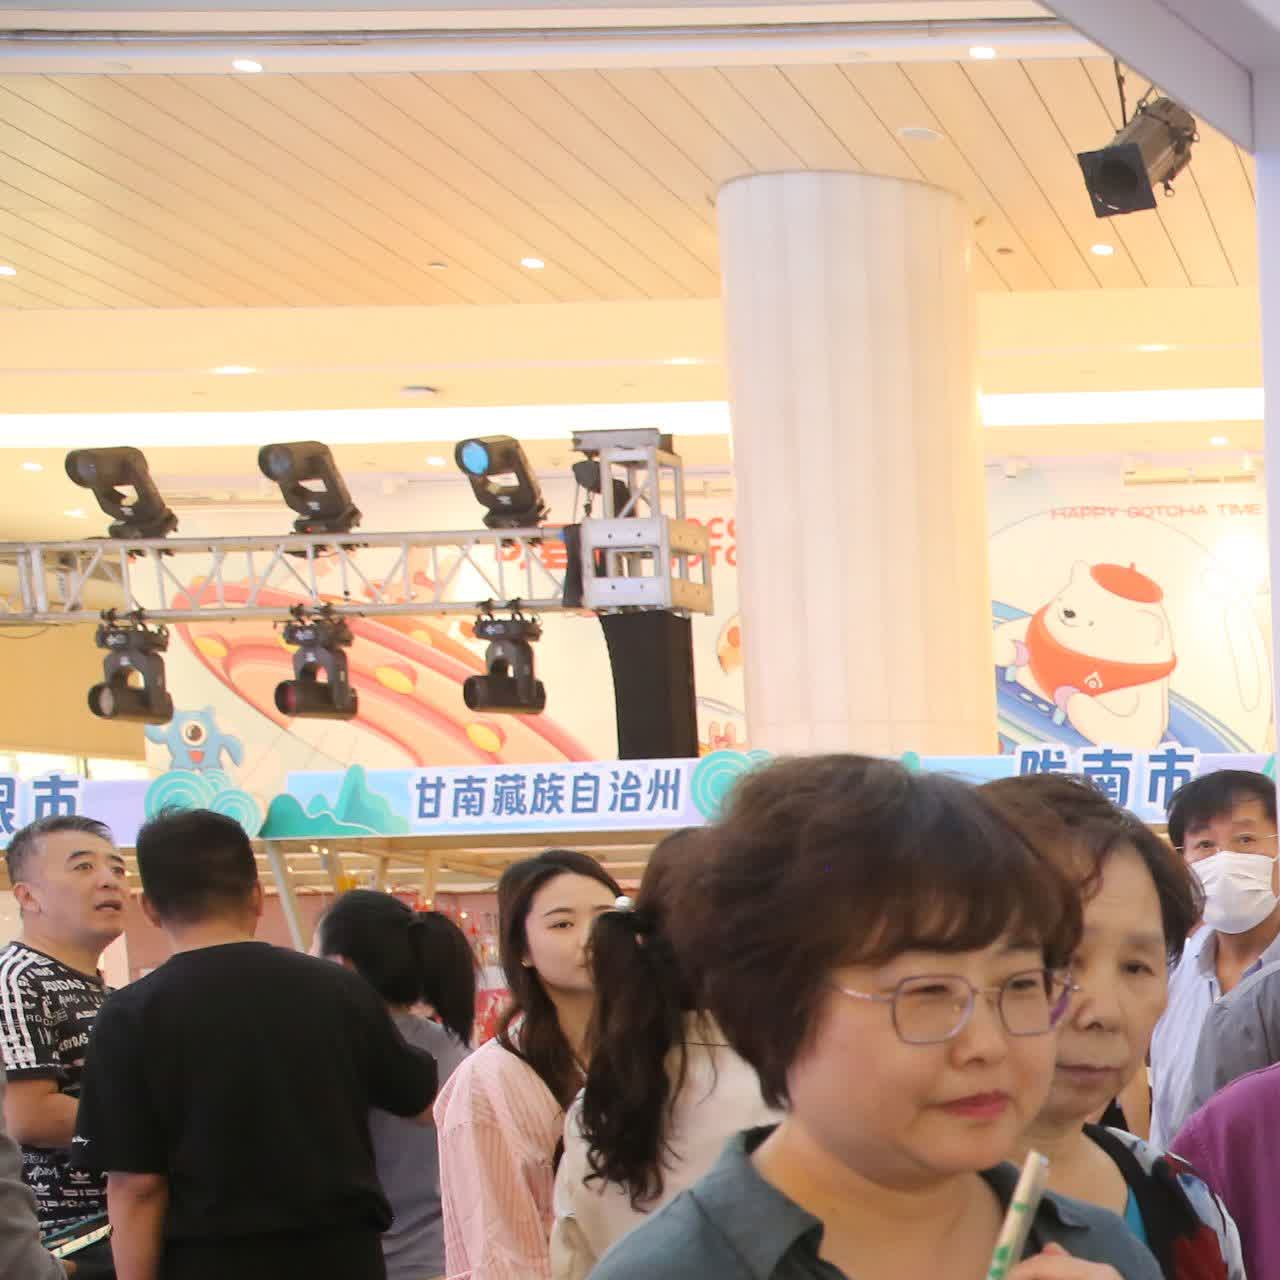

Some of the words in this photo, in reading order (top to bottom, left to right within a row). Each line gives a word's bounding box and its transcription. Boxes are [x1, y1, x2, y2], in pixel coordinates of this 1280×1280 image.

[1050, 505, 1120, 520] HAPPY
[415, 767, 681, 819] 甘南藏族自治州
